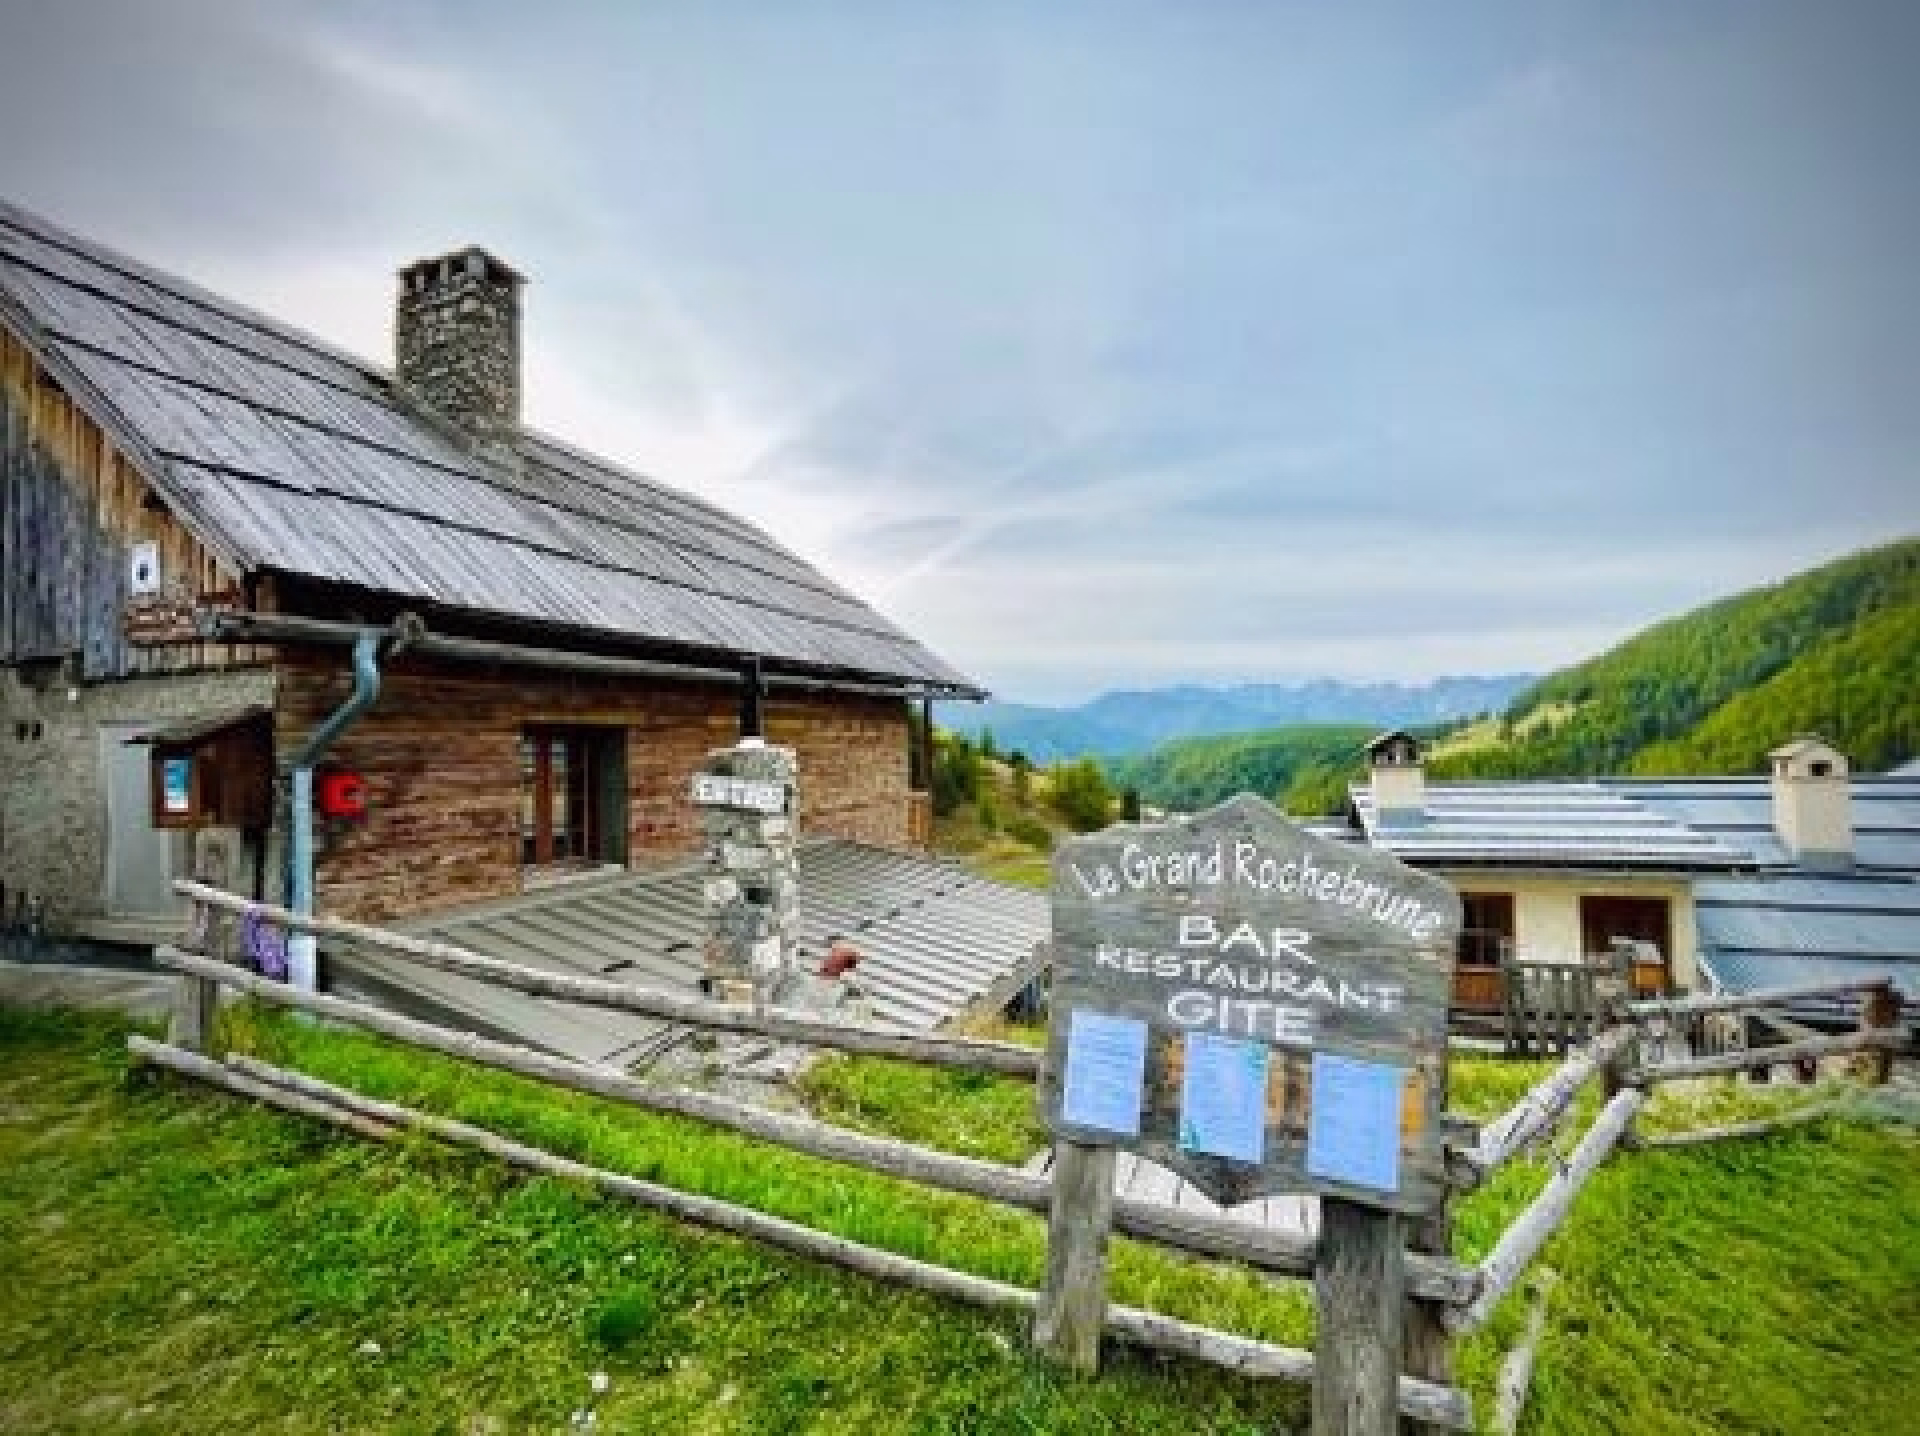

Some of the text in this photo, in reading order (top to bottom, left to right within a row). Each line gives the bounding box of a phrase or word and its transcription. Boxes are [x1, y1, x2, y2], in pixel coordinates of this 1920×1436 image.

[1071, 839, 1443, 938] Le Grand Rochebrune
[1178, 914, 1317, 966] BAR
[1096, 942, 1405, 1014] RESTAURANT
[1167, 991, 1314, 1046] GITE
